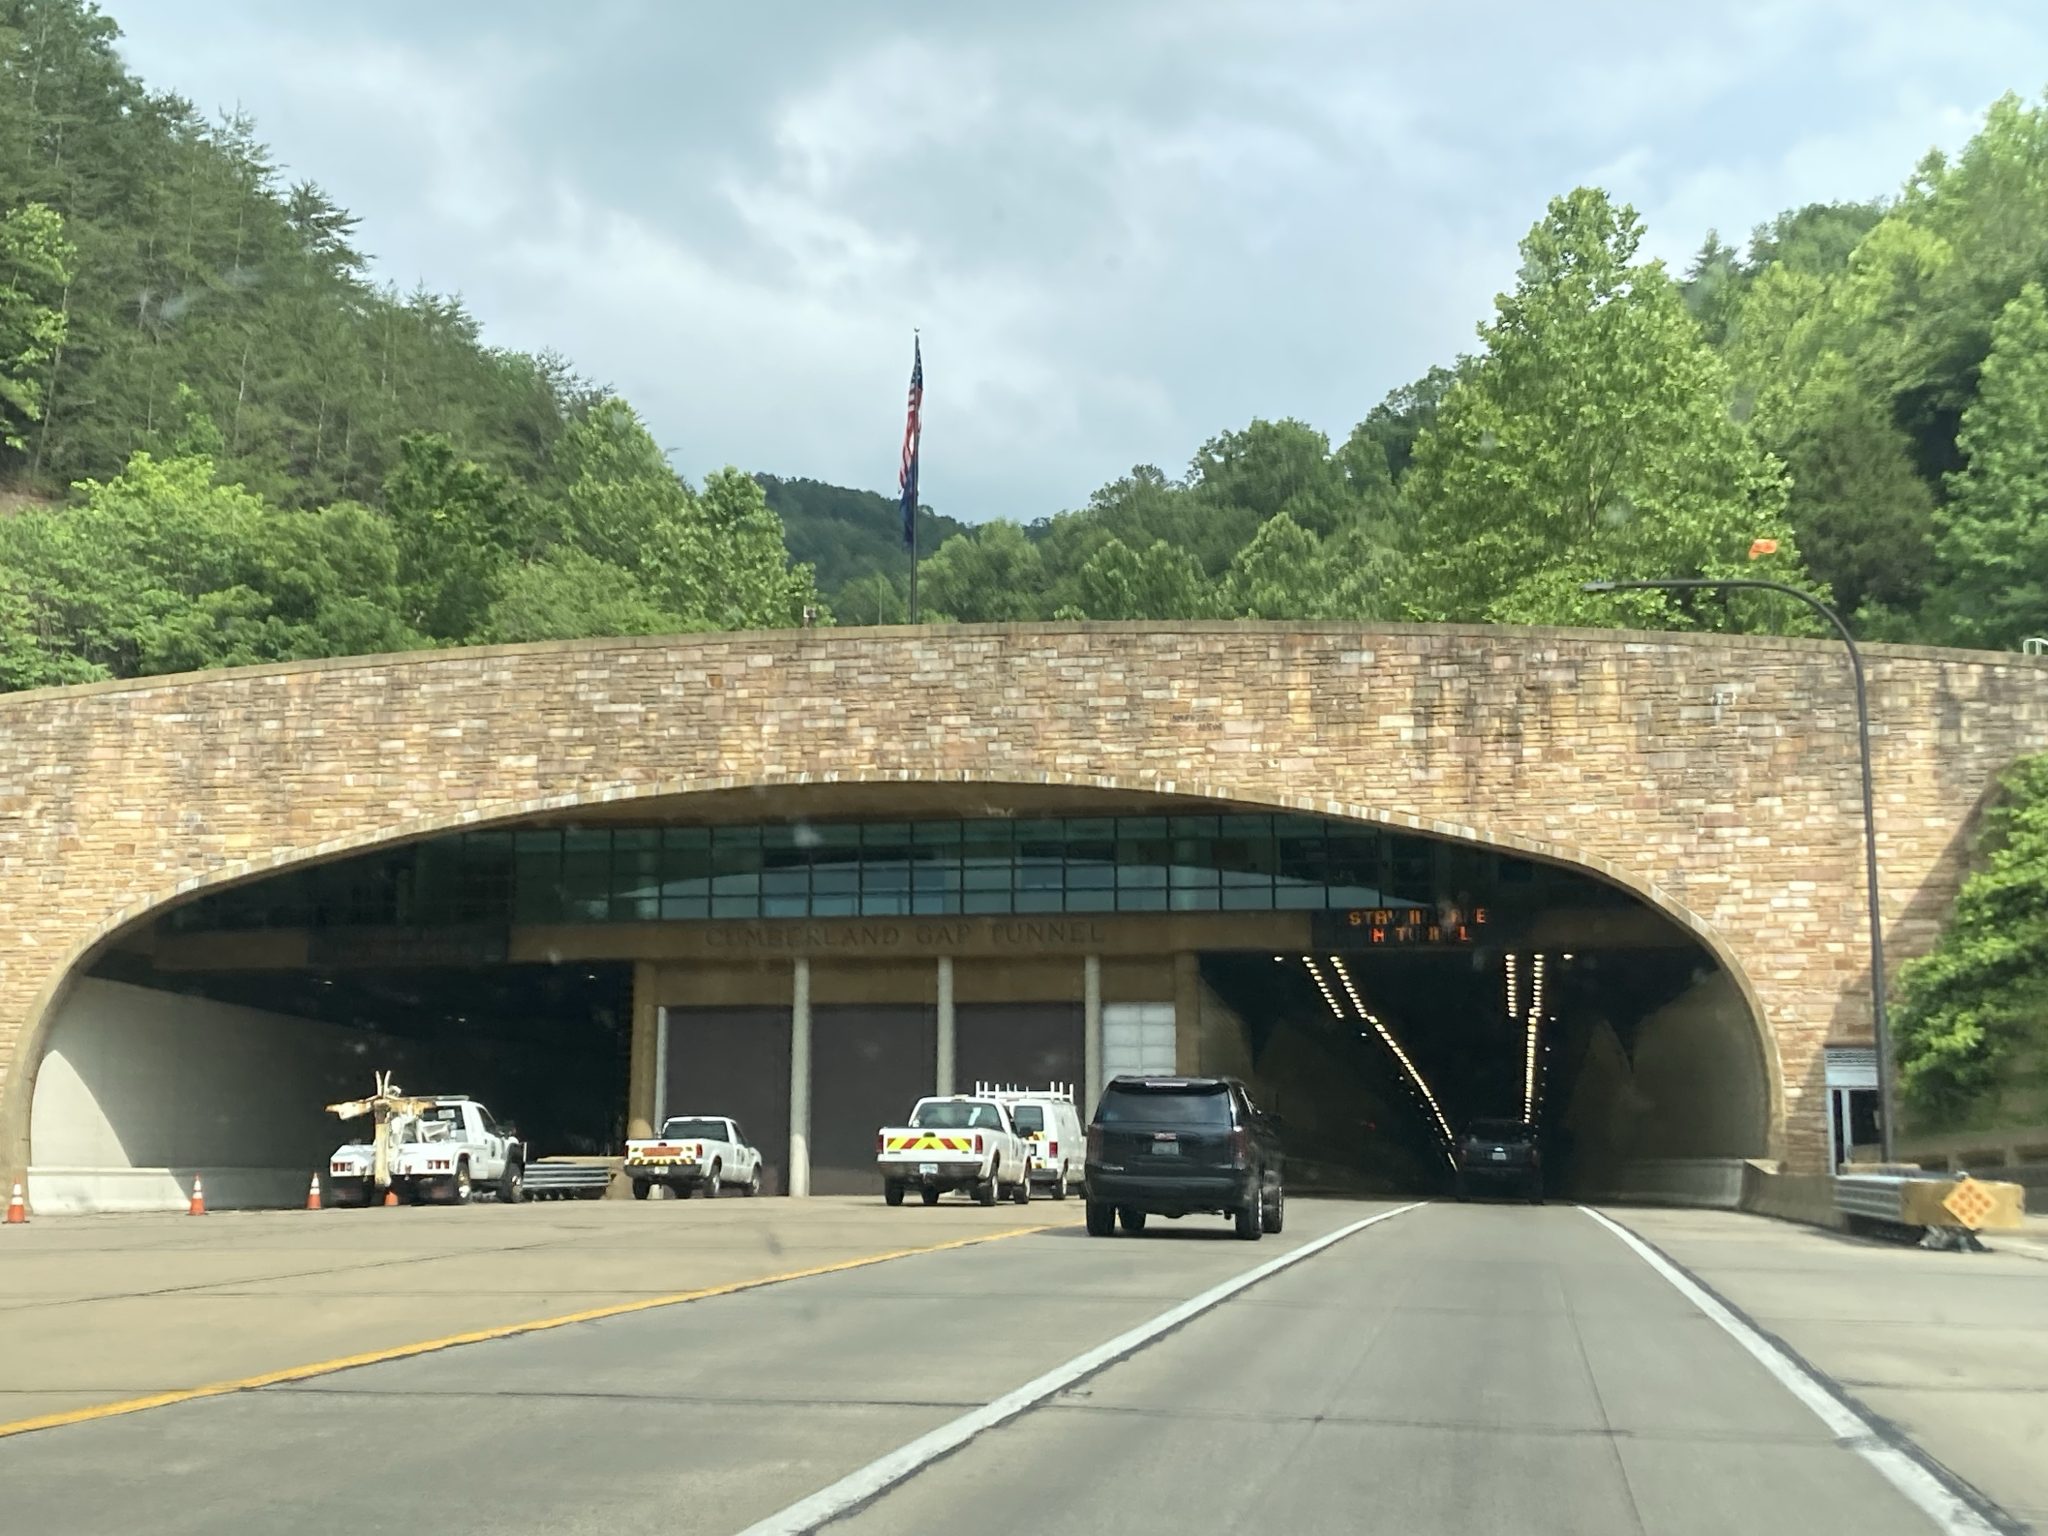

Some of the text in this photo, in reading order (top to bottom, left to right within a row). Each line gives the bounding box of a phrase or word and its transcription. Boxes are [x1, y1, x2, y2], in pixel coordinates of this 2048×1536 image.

[704, 922, 1103, 946] CUMBERLAND GAP TUNNEL
